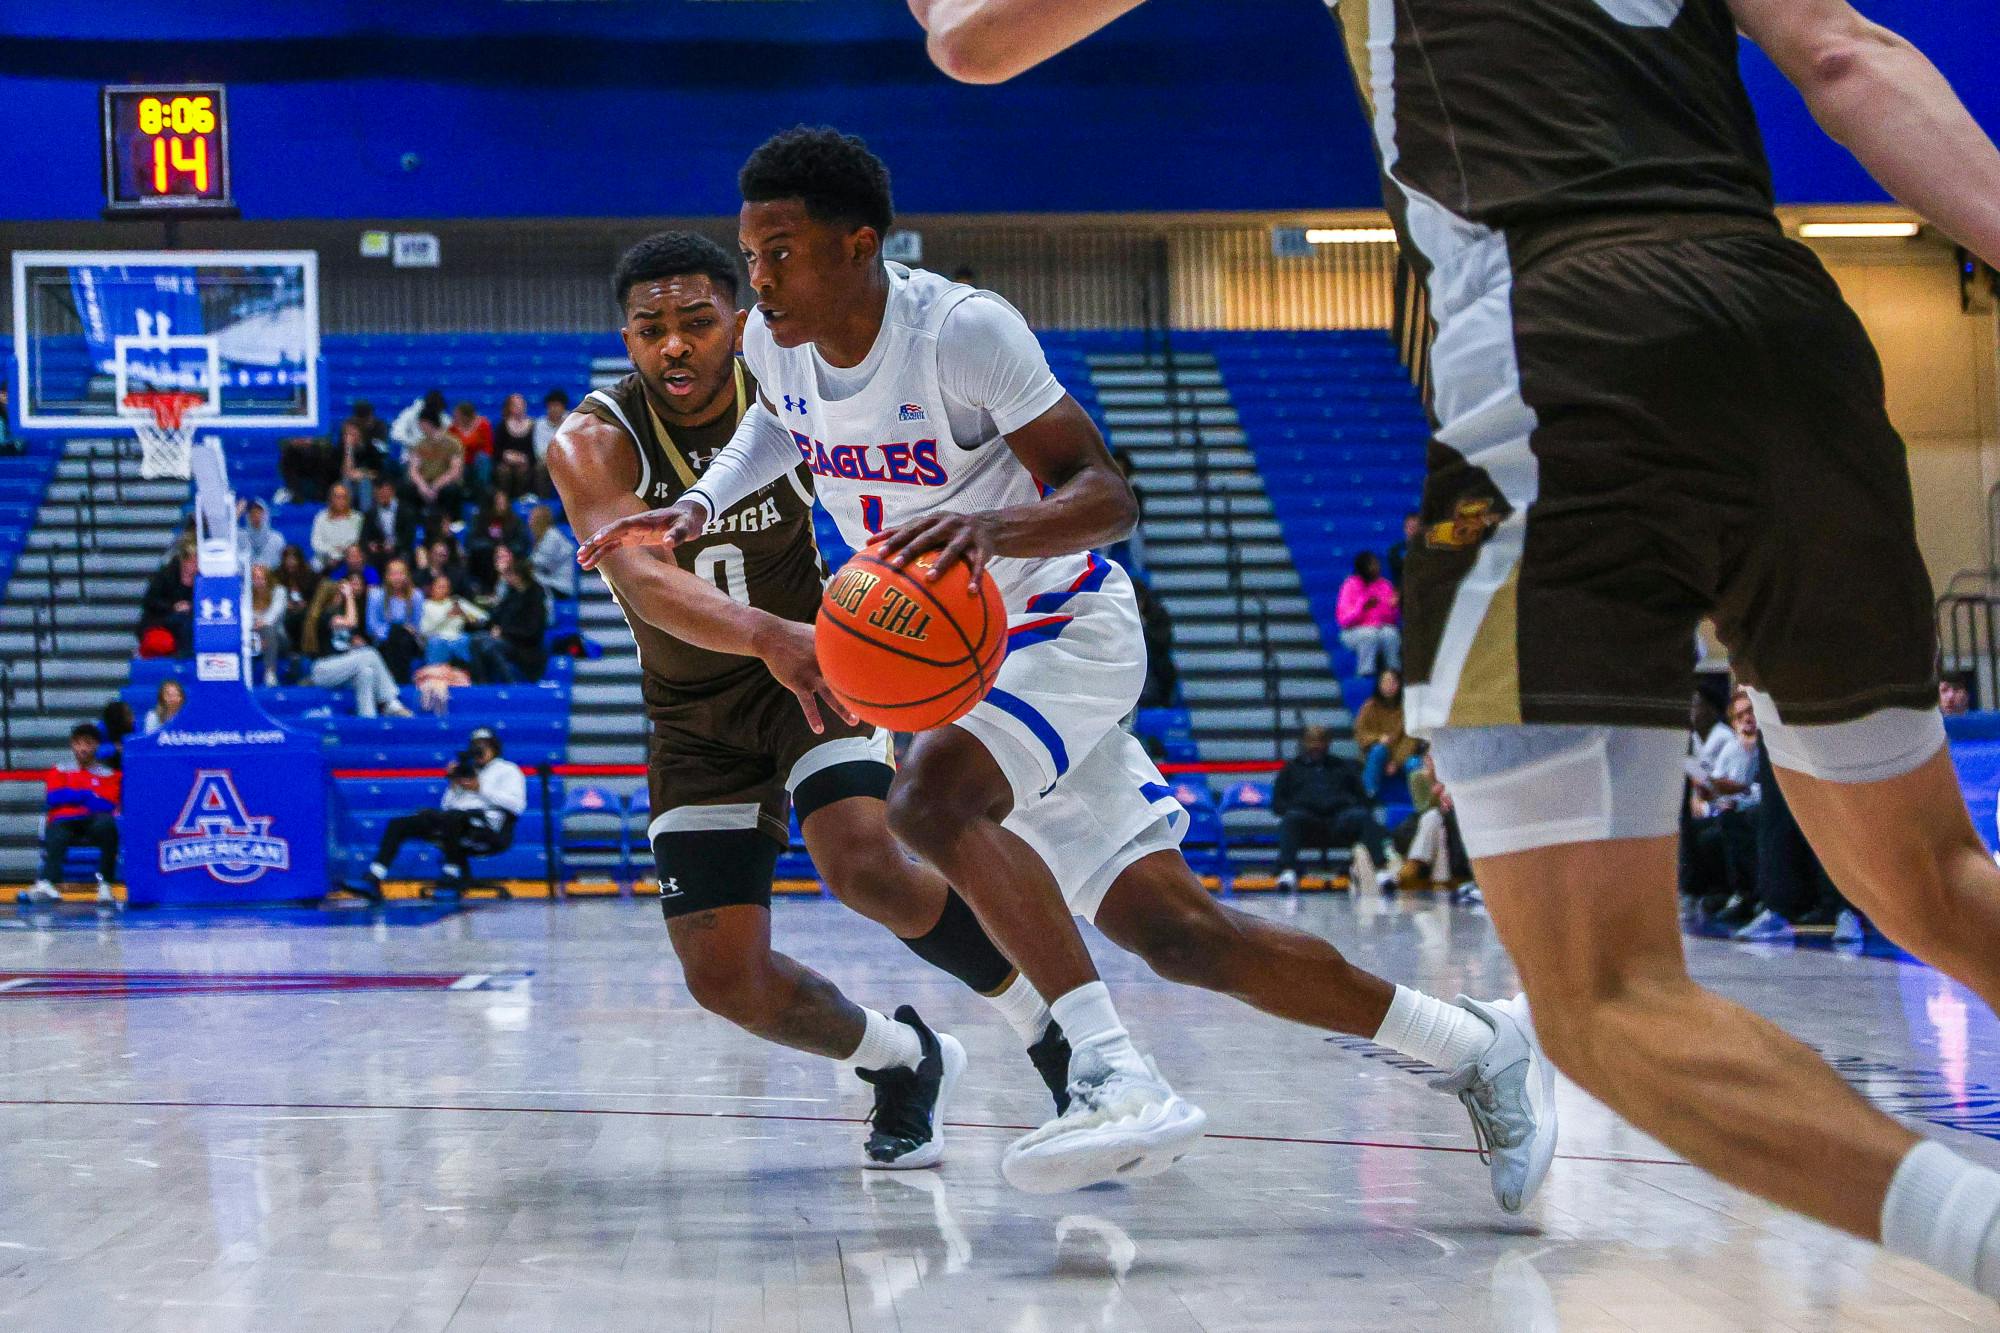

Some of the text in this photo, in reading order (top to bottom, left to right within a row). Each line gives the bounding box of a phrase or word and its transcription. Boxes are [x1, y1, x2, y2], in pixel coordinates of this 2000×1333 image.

[139, 97, 215, 134] 8:06
[154, 136, 208, 194] 14
[790, 429, 949, 487] EAGLES
[859, 495, 884, 535] 1
[694, 543, 751, 607] 0
[868, 585, 934, 642] THE
[158, 730, 285, 746] AUeagles.com
[167, 840, 282, 863] AMERICAN
